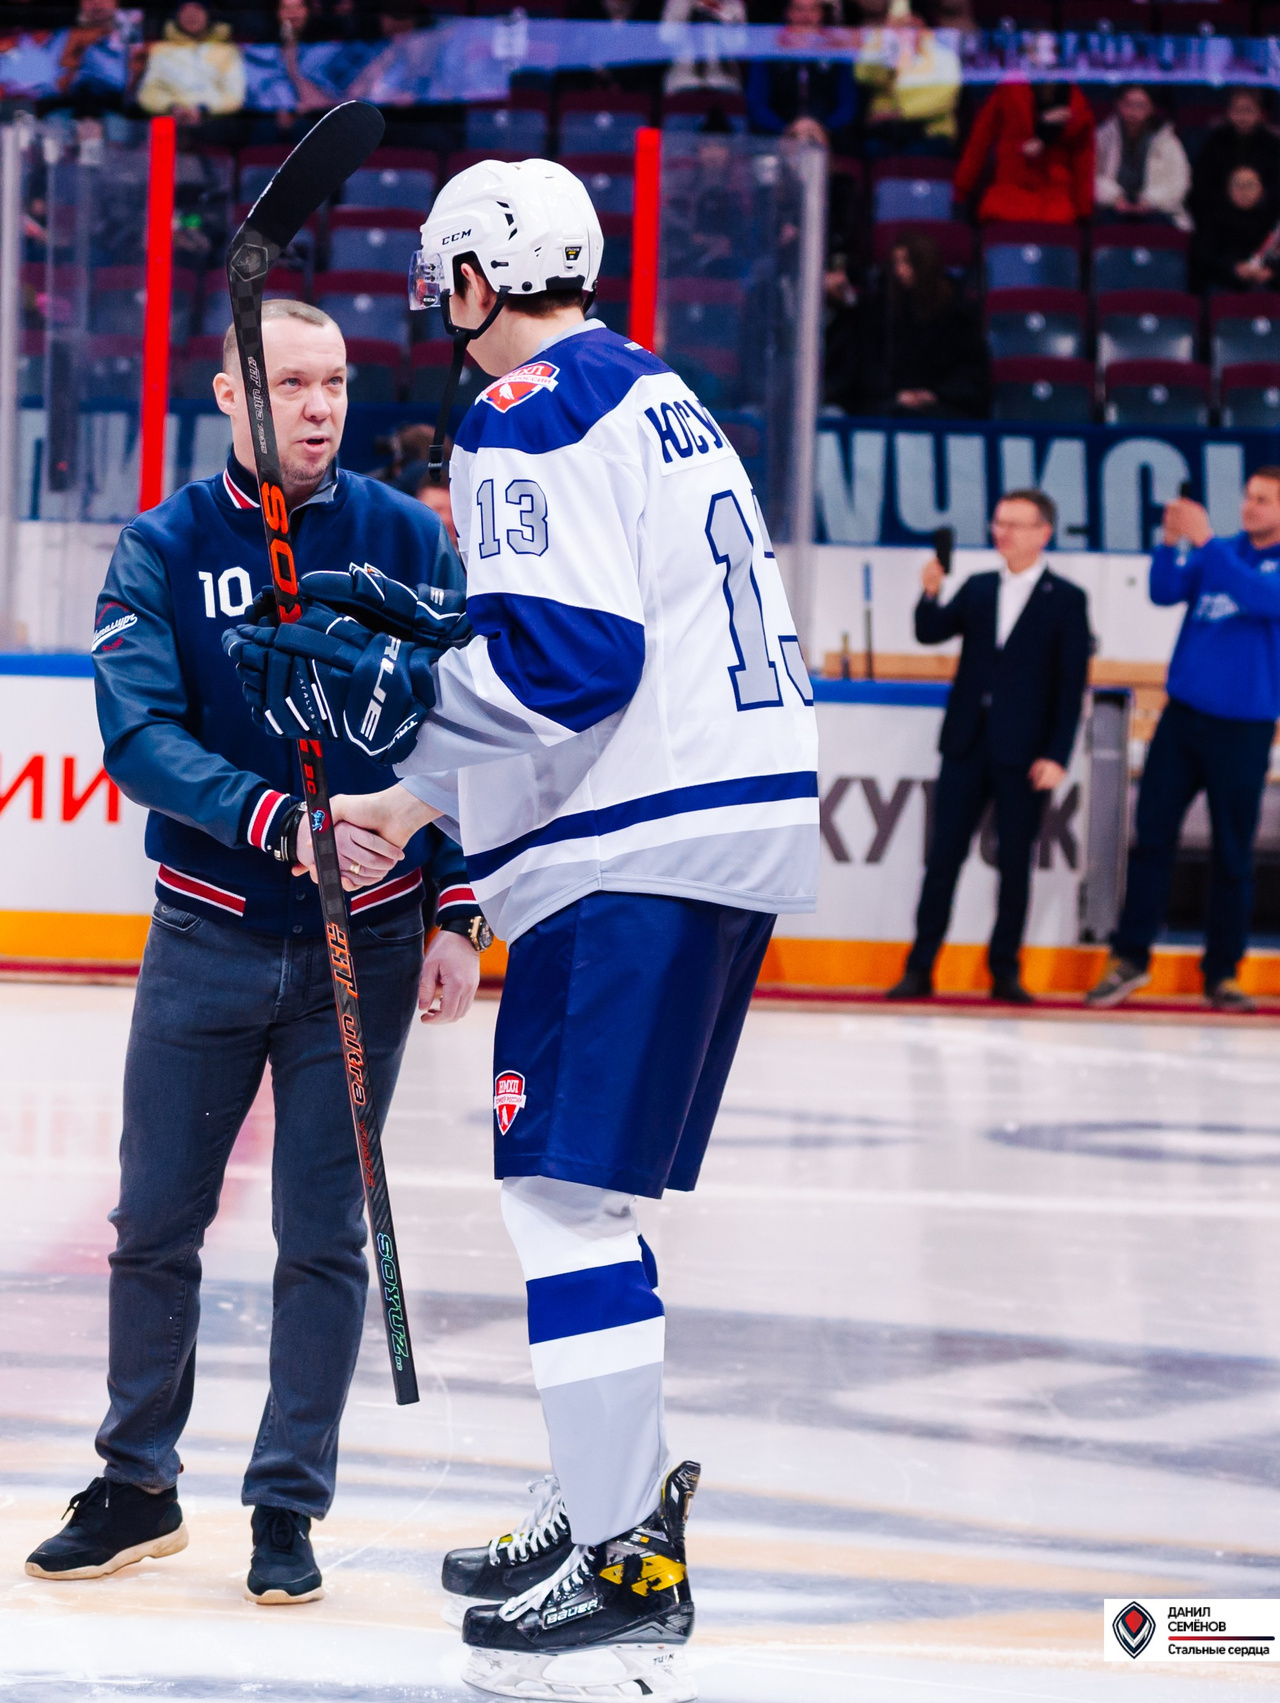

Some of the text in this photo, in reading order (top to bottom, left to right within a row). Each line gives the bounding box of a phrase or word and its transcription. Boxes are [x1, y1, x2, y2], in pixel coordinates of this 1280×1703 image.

[441, 229, 472, 246] CCM
[643, 399, 730, 464] ЮСУ
[476, 478, 550, 560] 13
[198, 566, 254, 619] 10
[360, 634, 402, 742] RUE
[342, 1013, 366, 1105] ultra
[376, 1232, 409, 1358] SOYUZ
